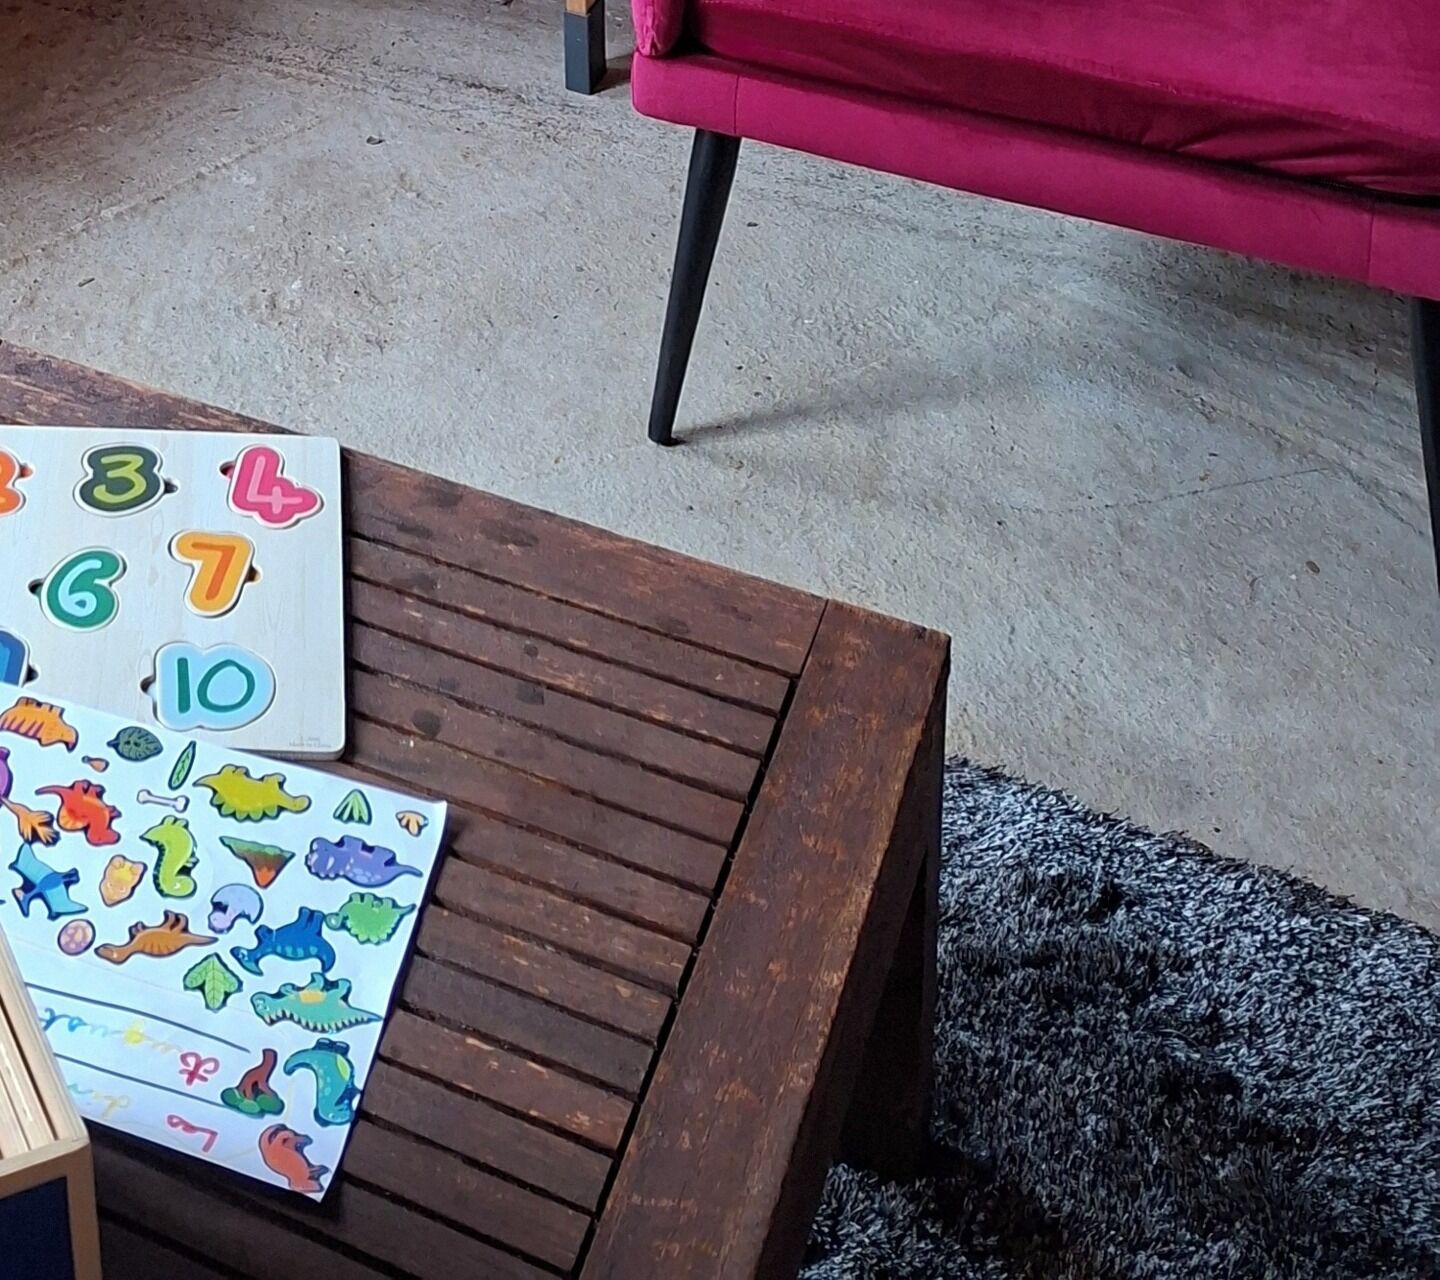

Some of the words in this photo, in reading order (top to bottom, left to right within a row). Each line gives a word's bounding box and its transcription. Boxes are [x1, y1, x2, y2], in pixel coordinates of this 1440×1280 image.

[92, 452, 148, 505] 3
[245, 453, 304, 516] 4
[57, 557, 104, 618] 6
[190, 540, 237, 602] 7
[175, 654, 258, 715] 10
